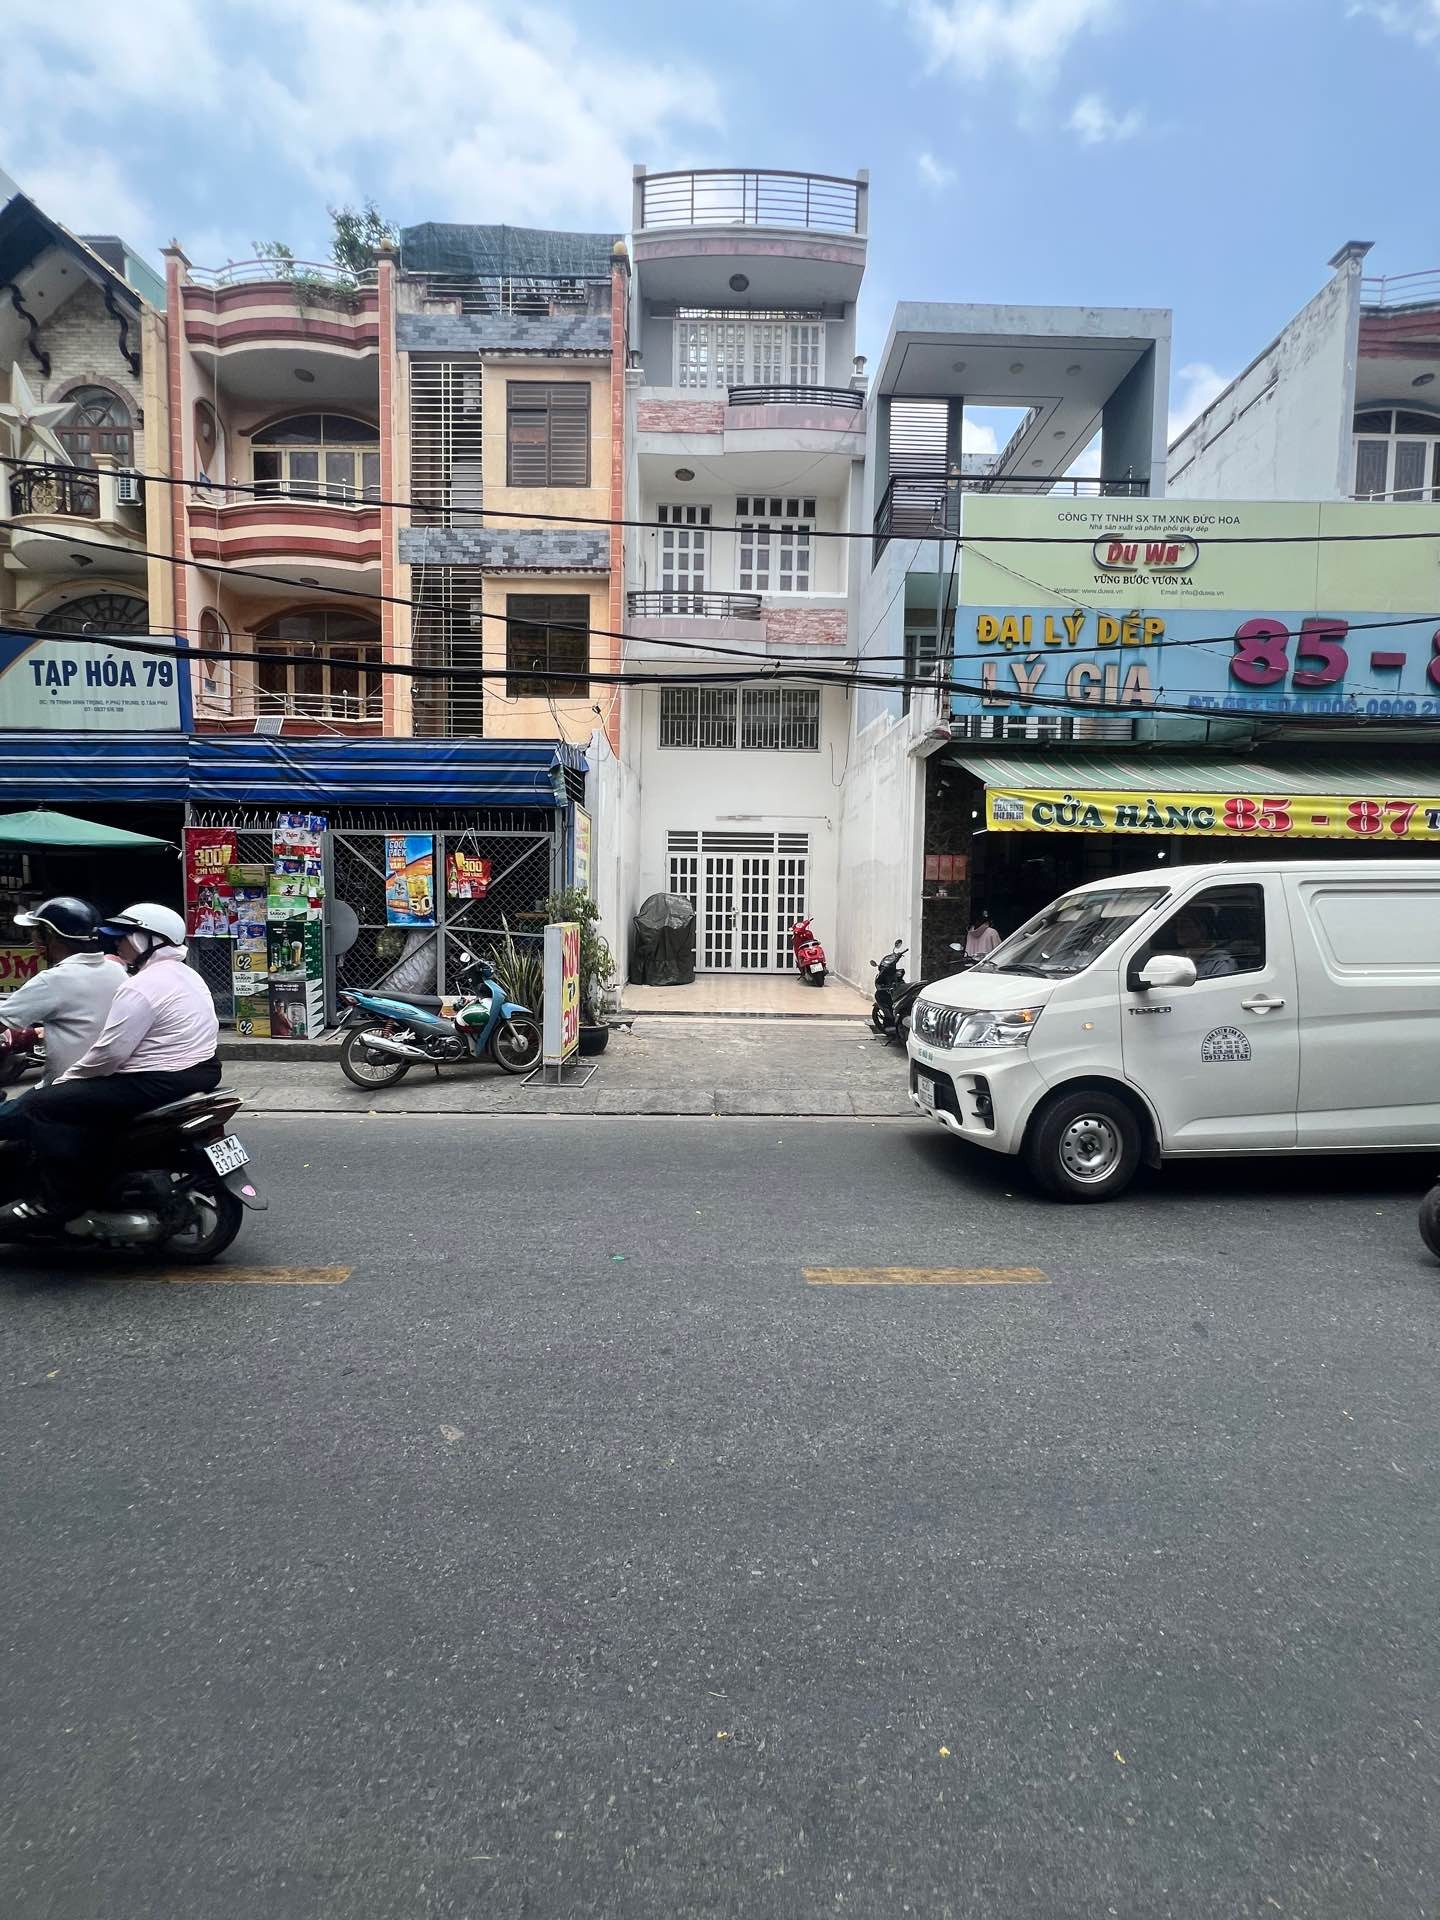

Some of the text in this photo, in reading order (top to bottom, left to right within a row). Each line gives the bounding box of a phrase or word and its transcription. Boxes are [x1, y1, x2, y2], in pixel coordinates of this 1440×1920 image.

[1057, 512, 1241, 525] CÔNG TY TNHH SX TM XNK ĐỨC HOA
[1094, 574, 1193, 585] VỮNG BƯỚC VƯƠN XA
[977, 608, 1166, 650] ĐẠI LÝ DÉP
[1231, 618, 1349, 687] 85
[29, 654, 174, 696] TẠP HÓA 79
[982, 654, 1151, 708] LÝ GIA
[1032, 794, 1105, 827] CỬA
[1115, 798, 1216, 830] HÀNG
[1222, 798, 1293, 831] 85
[1311, 815, 1329, 825] -
[1346, 800, 1418, 835] 87
[410, 896, 432, 912] 50
[237, 954, 251, 970] C2
[239, 1020, 253, 1035] C2
